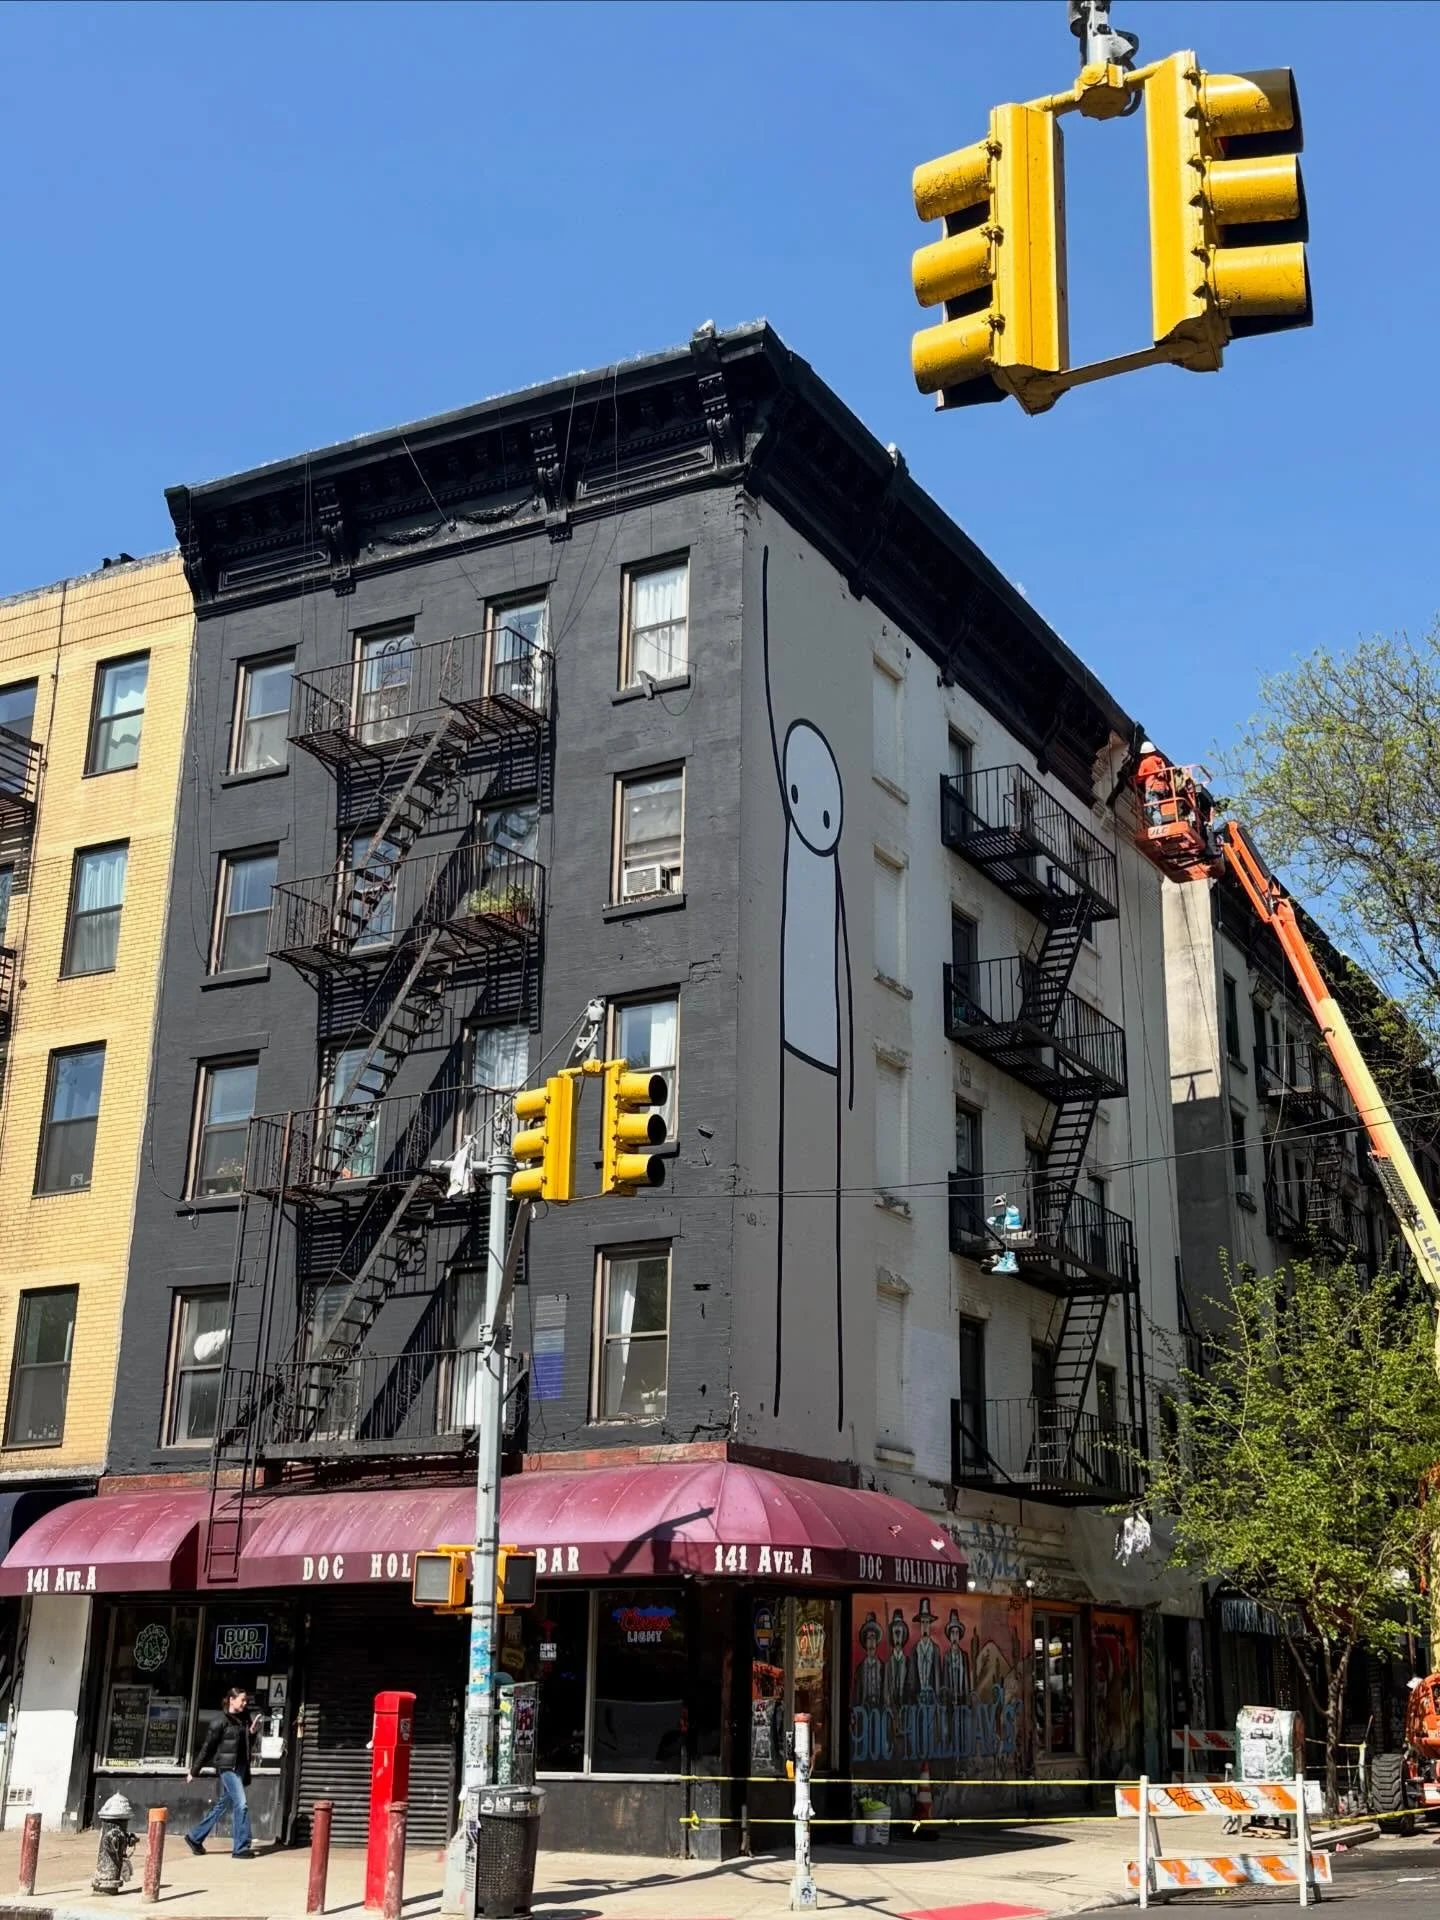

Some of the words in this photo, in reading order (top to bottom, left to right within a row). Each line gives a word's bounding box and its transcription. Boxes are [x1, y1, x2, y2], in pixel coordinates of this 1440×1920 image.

[302, 1555, 344, 1580] DOC
[536, 1547, 579, 1573] BAR
[715, 1545, 748, 1572] 141
[27, 1568, 49, 1592] 141
[859, 1554, 882, 1580] DOC
[895, 1558, 958, 1589] HOLLIDAY'S
[225, 1628, 258, 1644] BUD
[217, 1643, 264, 1660] LIGHT
[273, 1682, 284, 1697] A
